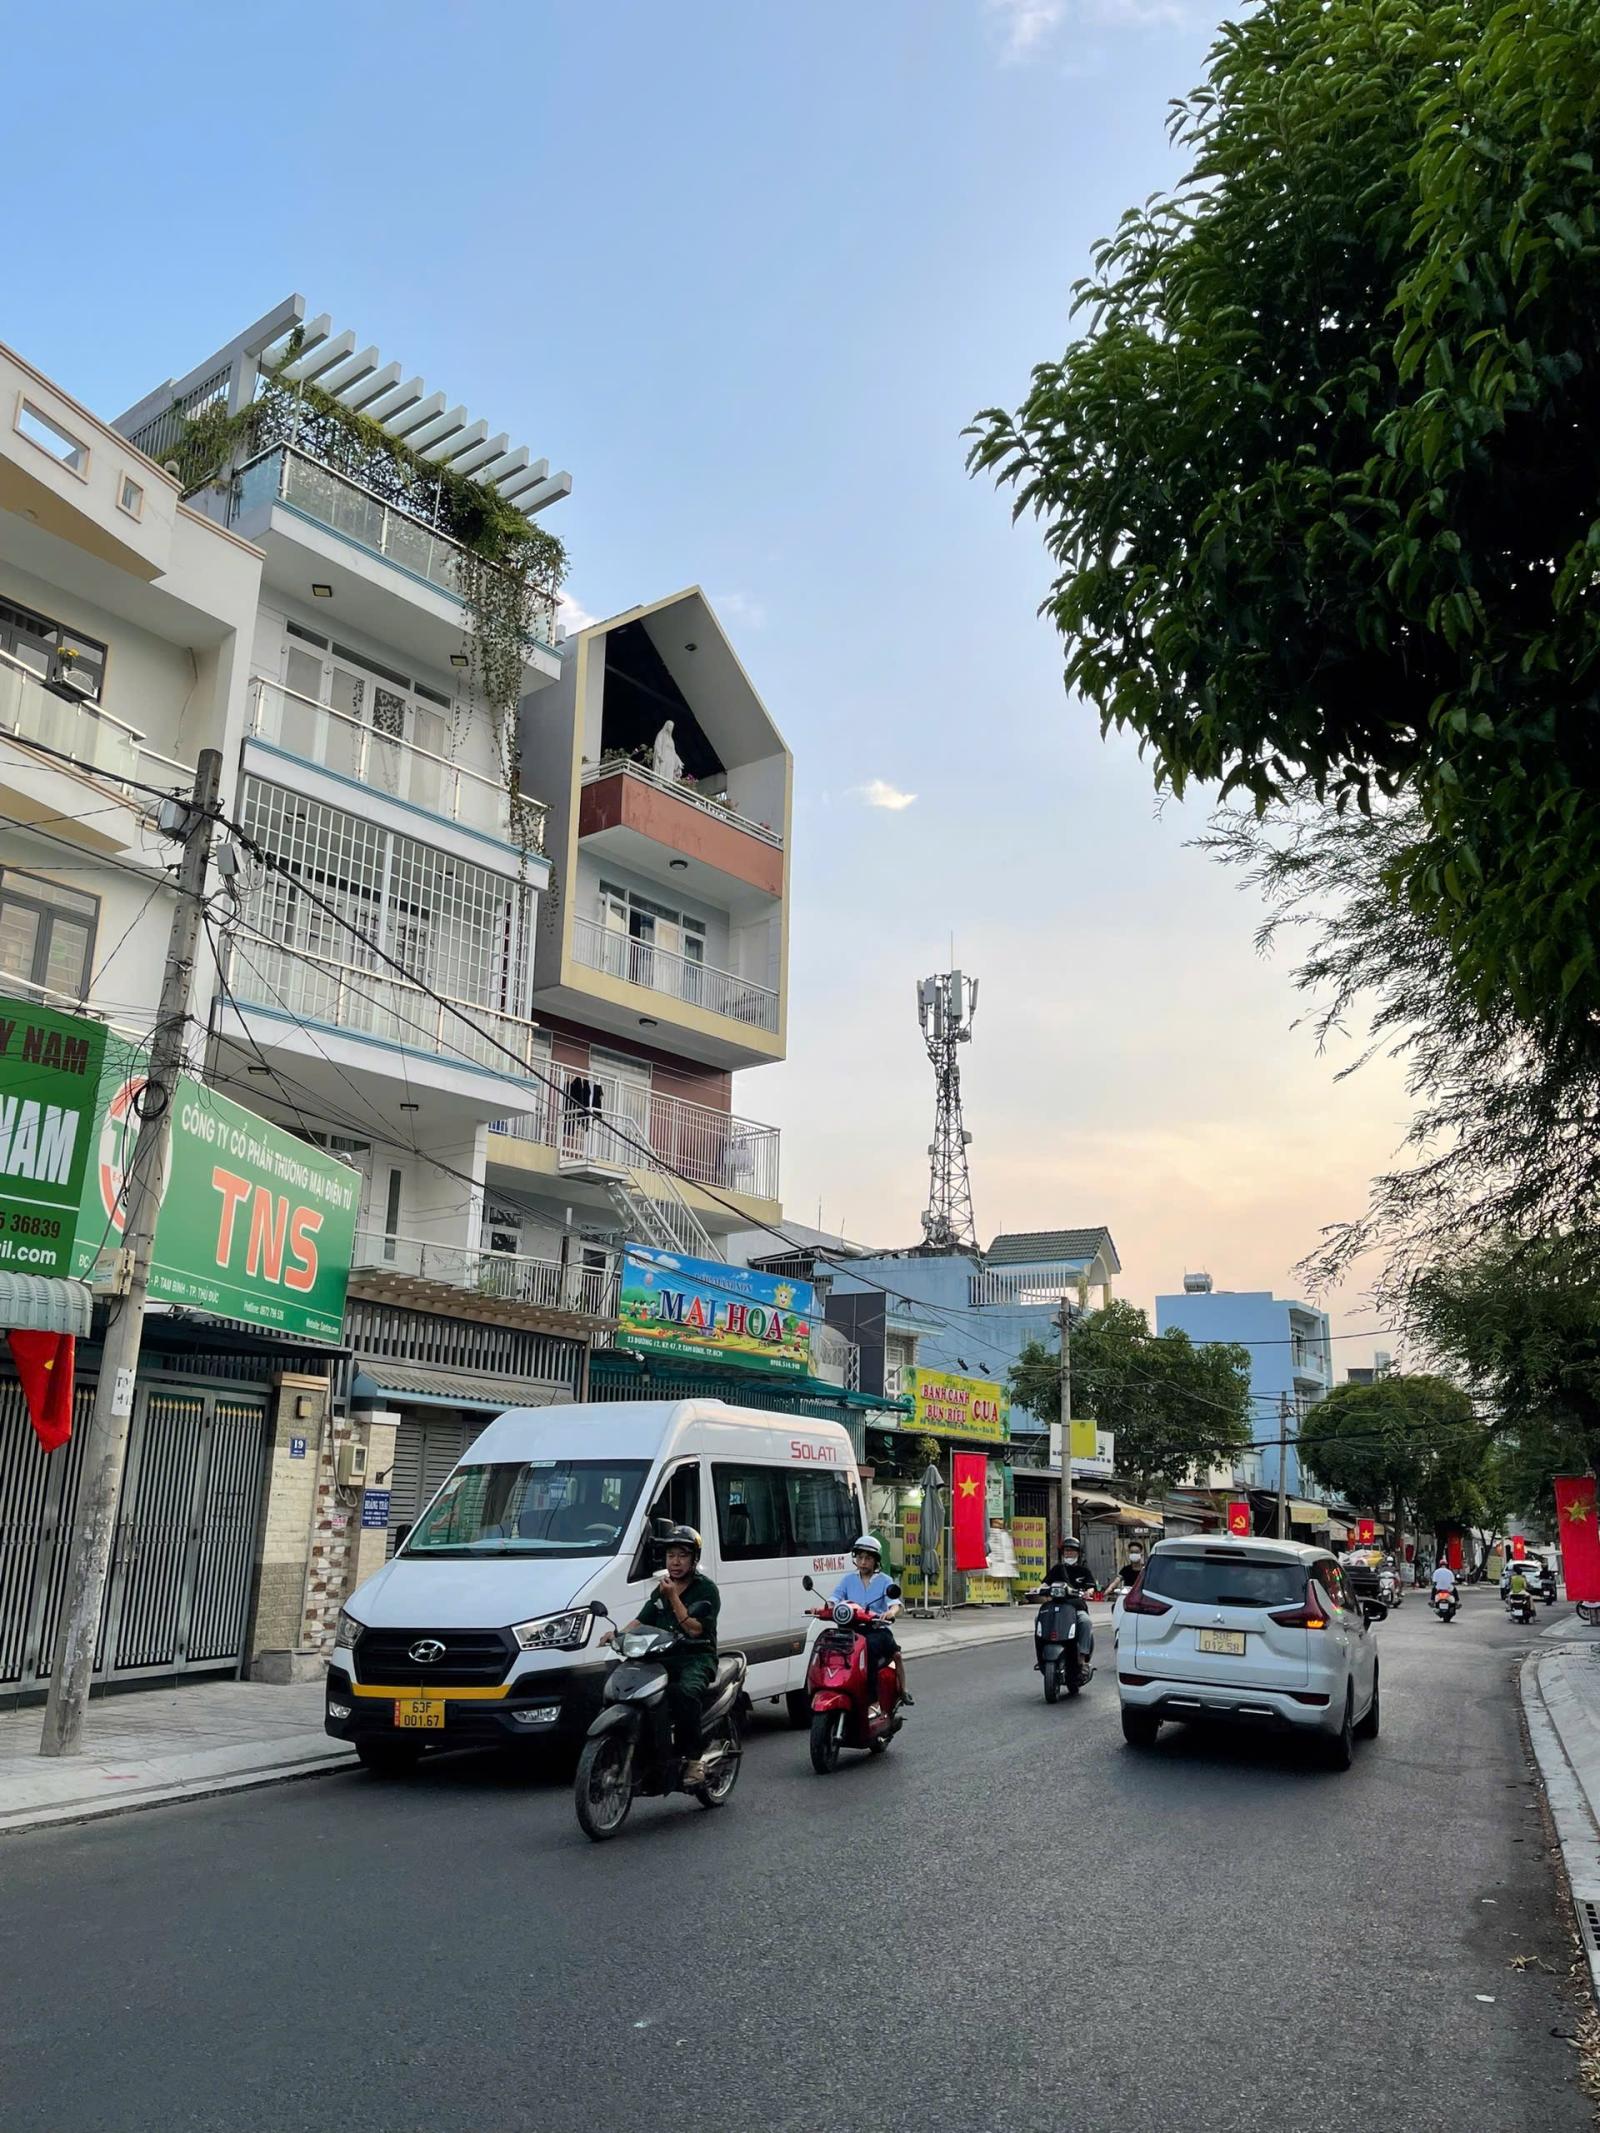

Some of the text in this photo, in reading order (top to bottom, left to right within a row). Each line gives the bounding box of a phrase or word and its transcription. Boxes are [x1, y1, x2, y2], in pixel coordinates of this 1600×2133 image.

[22, 1024, 89, 1076] NAM
[181, 1102, 215, 1143] CÔNG
[217, 1122, 230, 1150] TY
[10, 1213, 61, 1239] 36839
[210, 1165, 324, 1295] TNS
[656, 1288, 784, 1342] MAI HOA
[972, 1398, 999, 1424] CUA
[294, 1439, 304, 1449] 19
[790, 1440, 837, 1462] SOLATI
[412, 1701, 432, 1713] 63F
[404, 1714, 440, 1727] 001.67
